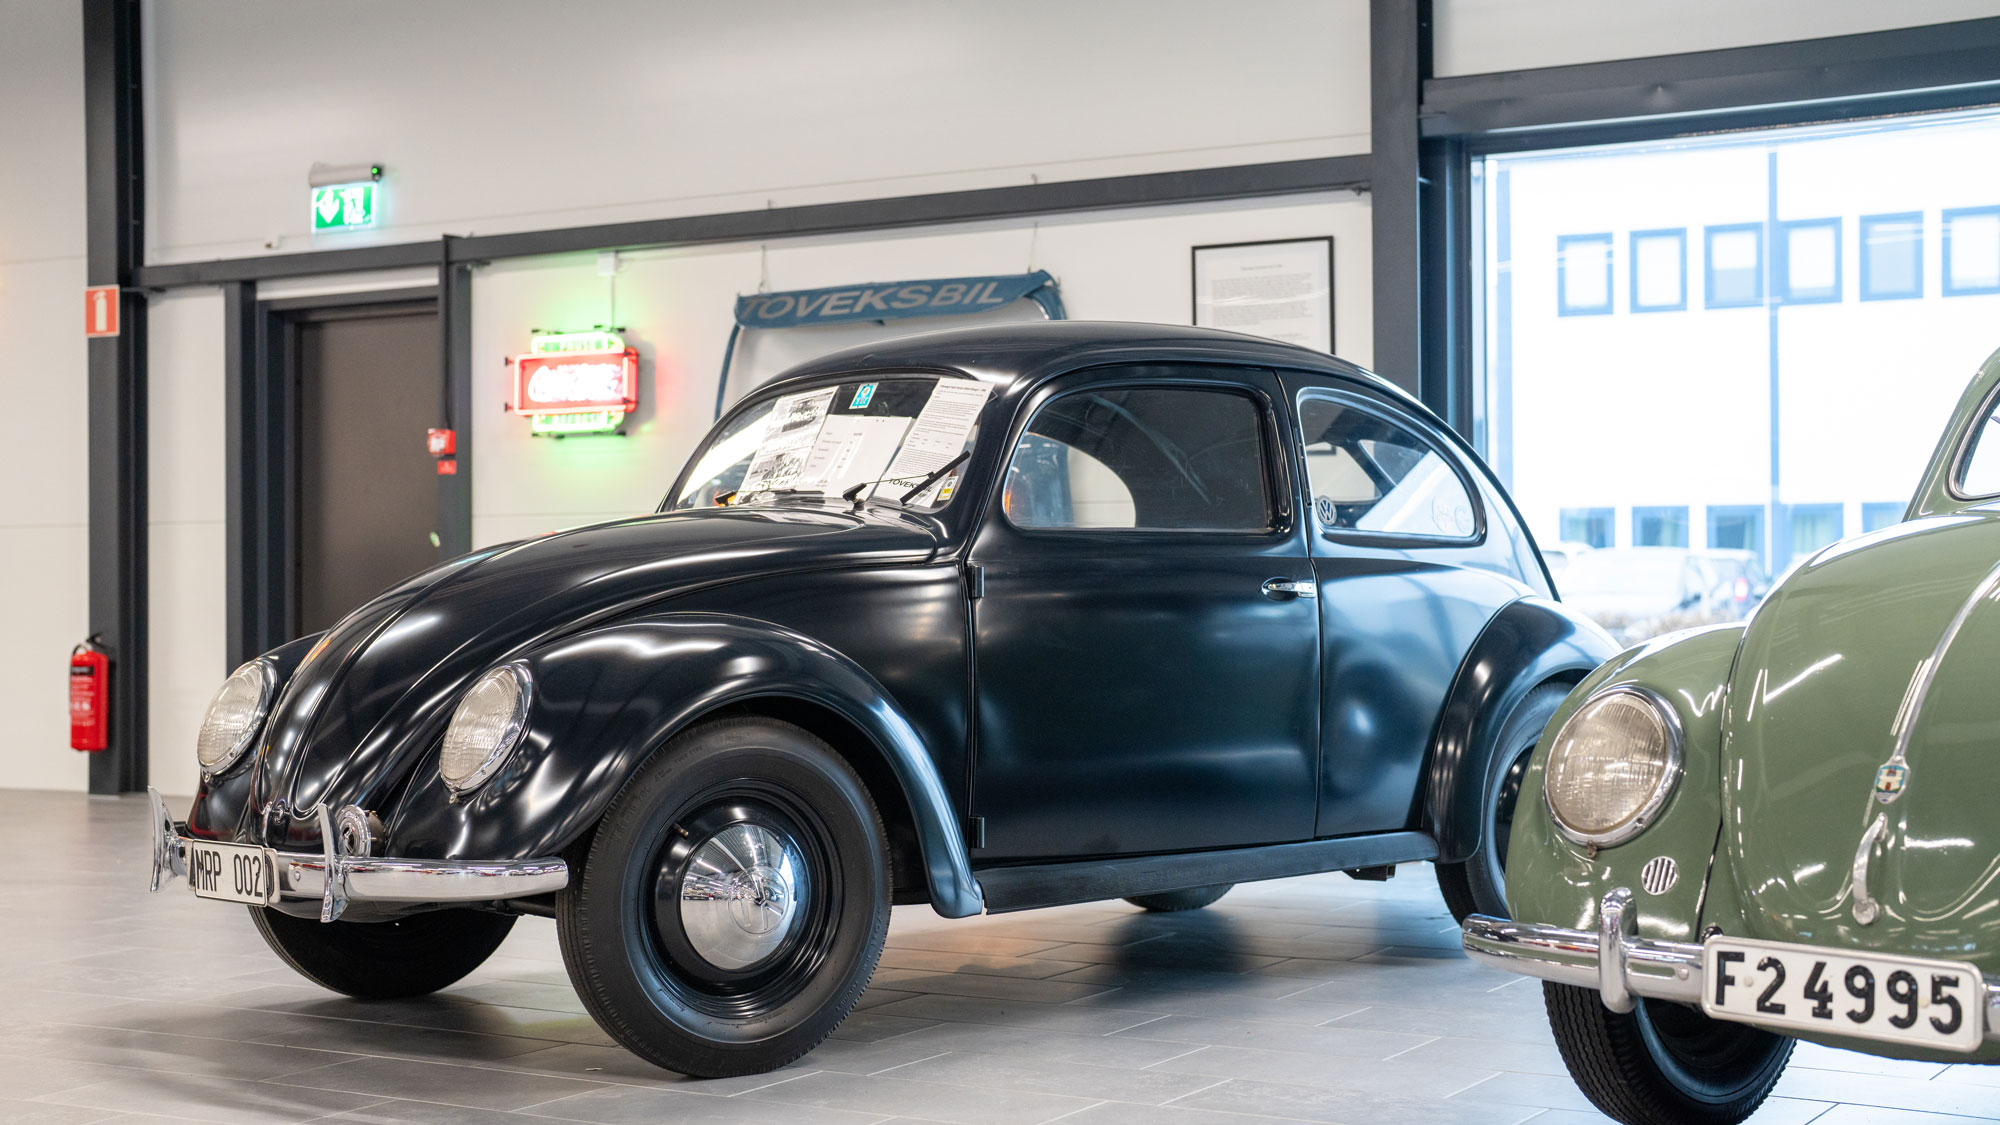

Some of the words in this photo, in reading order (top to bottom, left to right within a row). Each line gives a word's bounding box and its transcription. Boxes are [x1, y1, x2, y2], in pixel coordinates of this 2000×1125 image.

[742, 282, 1004, 319] TOVEKSBIL
[196, 849, 222, 892] MRP
[233, 853, 263, 898] 002
[1715, 951, 1963, 1035] F24995
